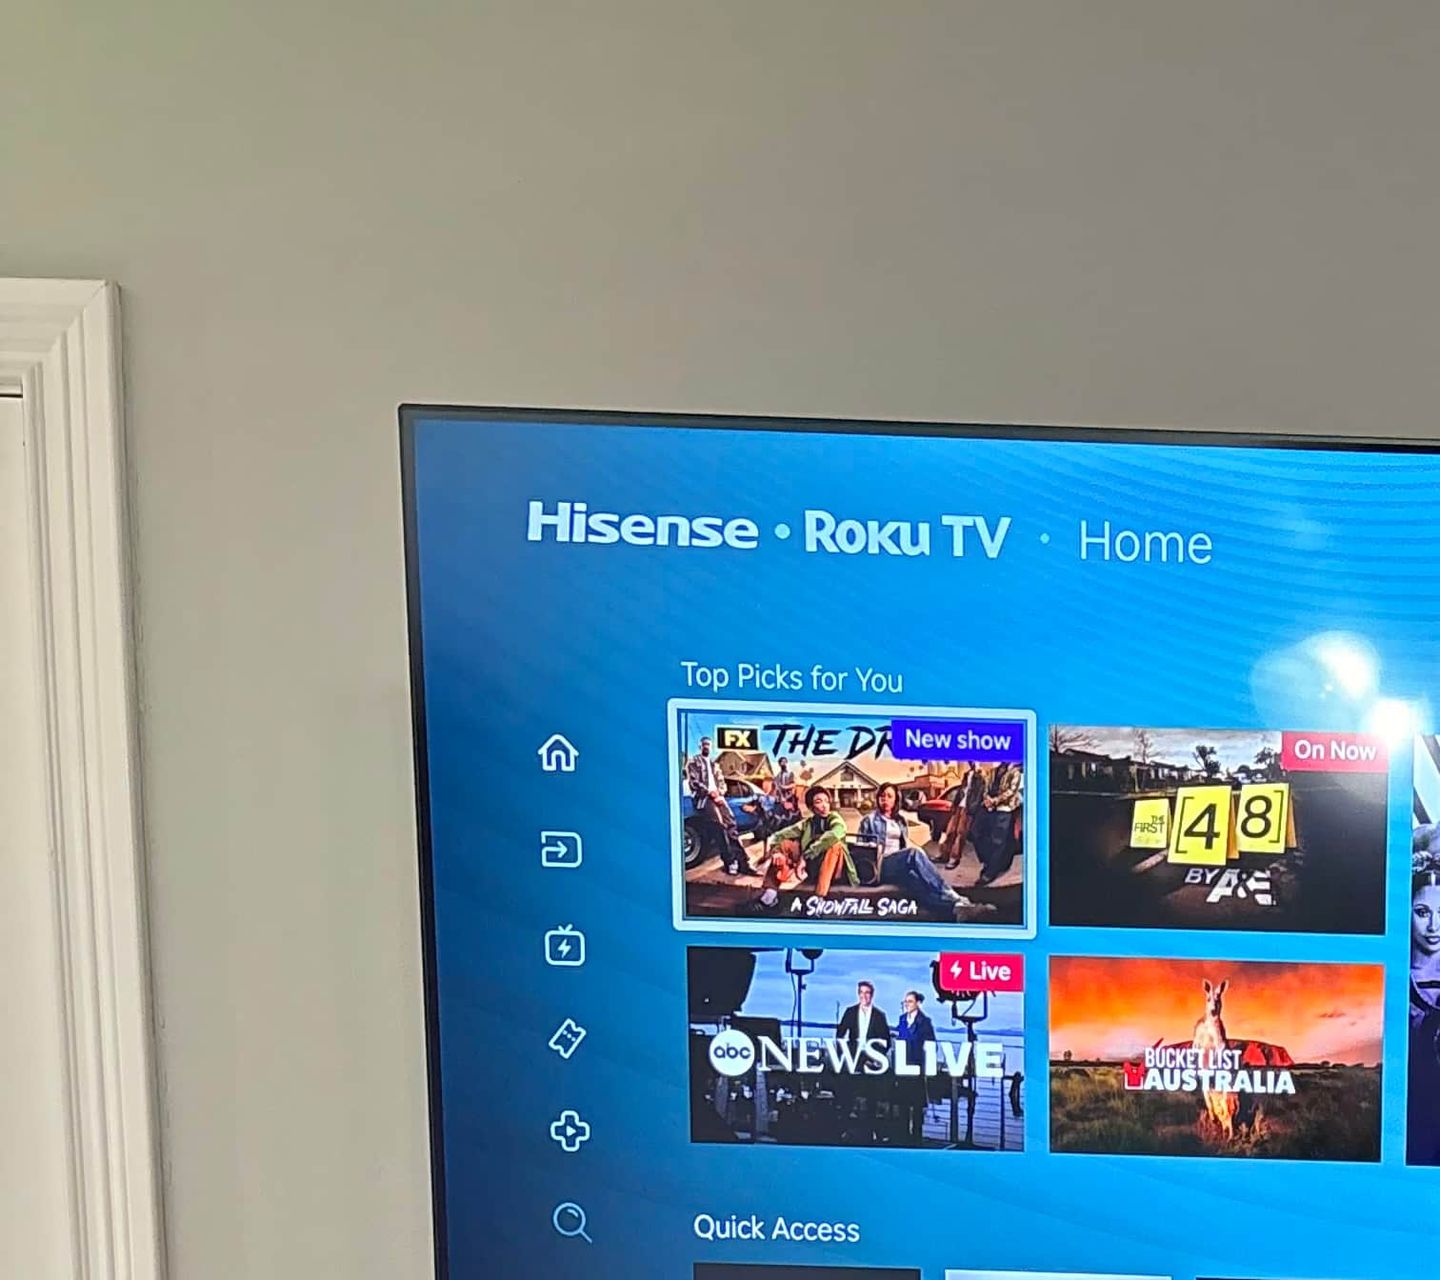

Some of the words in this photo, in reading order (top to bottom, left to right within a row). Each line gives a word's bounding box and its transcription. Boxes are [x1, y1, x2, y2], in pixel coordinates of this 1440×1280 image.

[528, 502, 759, 550] Hisense
[805, 509, 930, 556] Roku
[942, 514, 1011, 558] TV
[1079, 521, 1213, 565] Home
[680, 661, 729, 691] Top
[738, 662, 802, 691] Picks
[810, 664, 849, 692] for
[854, 667, 904, 694] You
[723, 729, 752, 749] FX
[763, 723, 842, 760] THE
[906, 727, 954, 750] New
[957, 730, 1012, 752] show
[1294, 740, 1324, 761] On
[1328, 739, 1377, 761] Now
[1134, 822, 1165, 834] FIRST
[1185, 867, 1219, 885] BY
[790, 899, 802, 913] A
[877, 898, 918, 917] SAGA
[969, 961, 1011, 981] Live
[713, 1042, 751, 1061] abc
[1144, 1045, 1200, 1069] BUCKET
[1206, 1047, 1242, 1069] LIST
[1143, 1068, 1296, 1095] AUSTRALIA
[694, 1213, 765, 1241] Quick
[772, 1216, 860, 1243] Access
